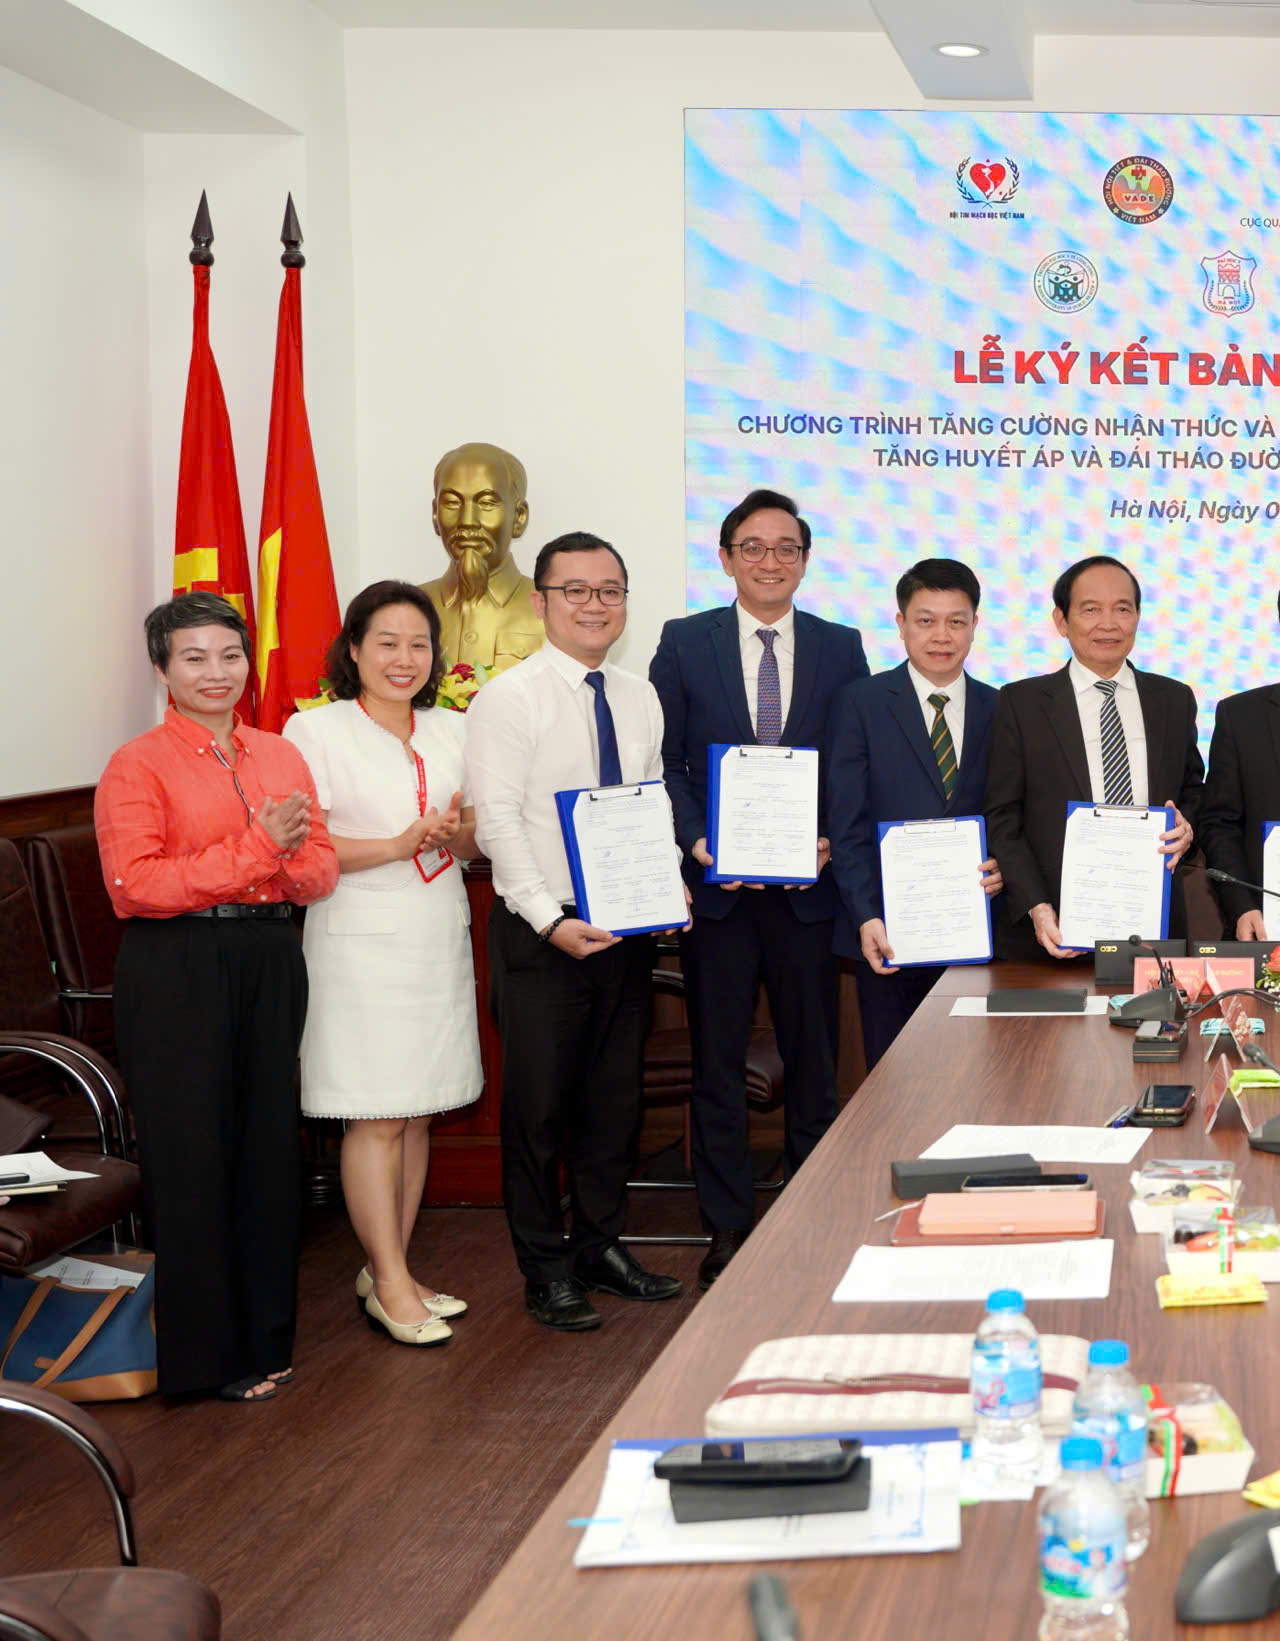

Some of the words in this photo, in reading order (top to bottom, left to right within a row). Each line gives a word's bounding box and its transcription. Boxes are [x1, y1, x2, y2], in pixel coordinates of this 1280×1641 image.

[1124, 194, 1154, 202] VADE
[1139, 213, 1157, 223] NAM
[1240, 217, 1262, 228] CỤC
[954, 334, 1004, 384] LỄ
[1014, 341, 1080, 384] KÝ
[1090, 336, 1179, 385] KẾT
[737, 413, 843, 434] CHƯƠNG
[850, 411, 922, 435] TRÌNH
[928, 412, 994, 435] TĂNG
[1000, 413, 1088, 436] CƯỜNG
[1095, 413, 1164, 441] NHẬN
[1171, 414, 1238, 438] THỨC
[1244, 415, 1276, 438] VÀ
[873, 443, 939, 467] TĂNG
[946, 441, 1026, 468] HUYẾT
[1032, 445, 1064, 468] ÁP
[1071, 445, 1103, 468] VÀ
[1109, 445, 1151, 468] ĐÁI
[1157, 446, 1224, 469] THÁO
[1110, 499, 1143, 518] Hà
[1148, 499, 1191, 523] Nội,
[1199, 500, 1260, 524] Ngày
